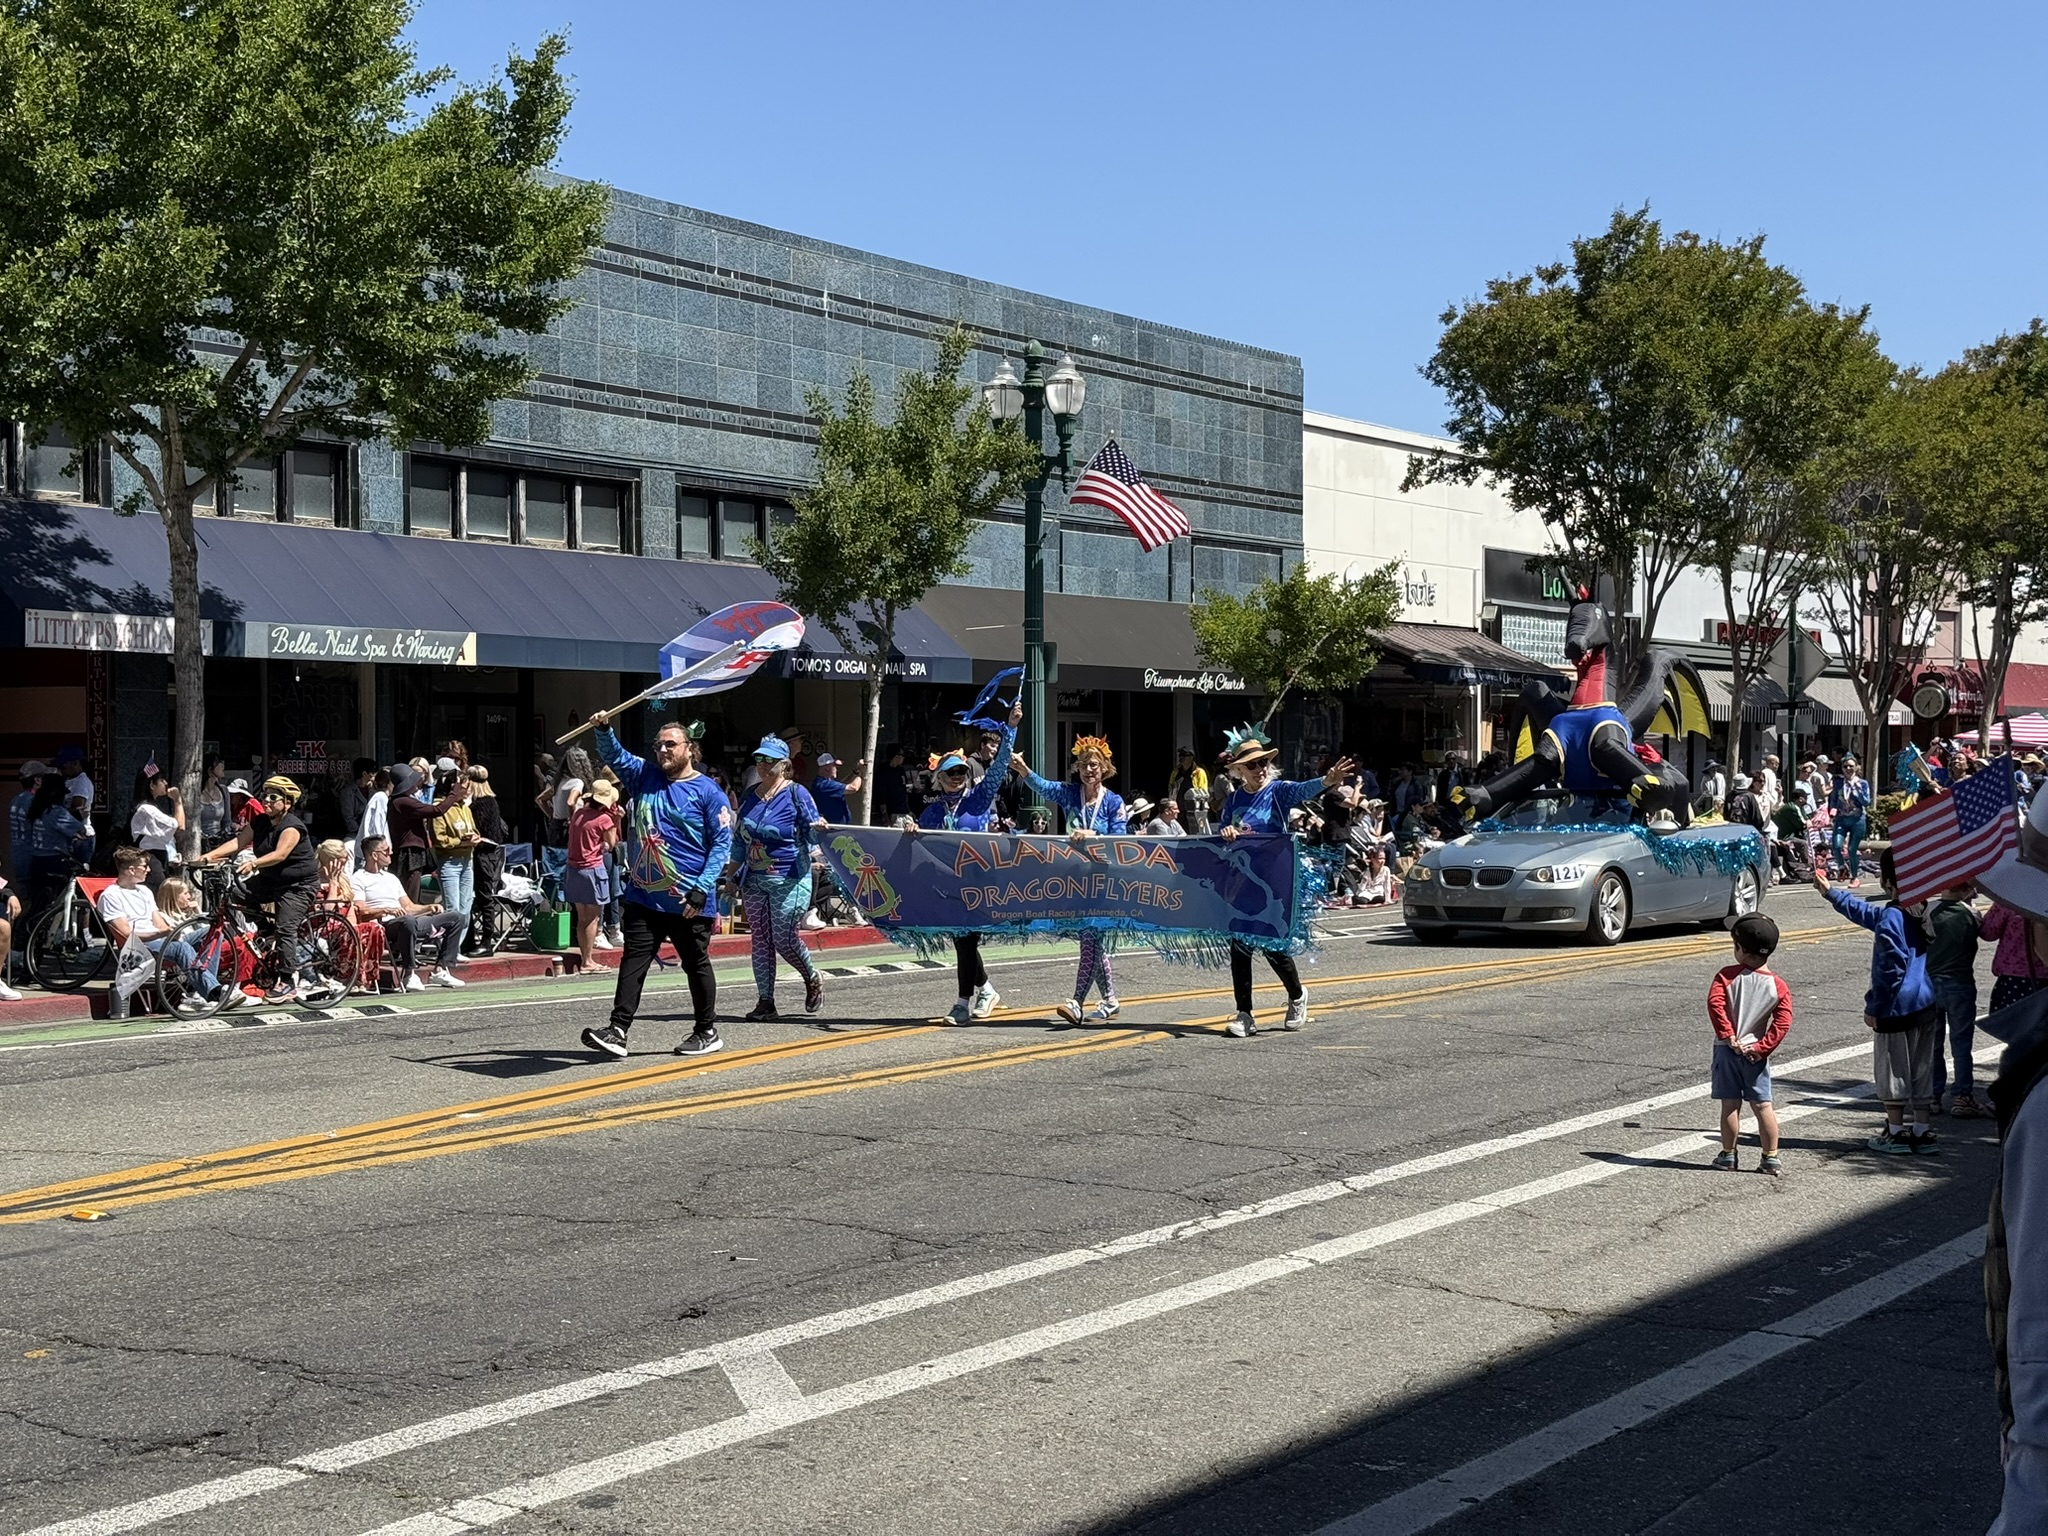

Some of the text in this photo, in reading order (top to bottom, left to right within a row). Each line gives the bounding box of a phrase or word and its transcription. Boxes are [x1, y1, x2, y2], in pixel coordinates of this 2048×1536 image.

[33, 616, 91, 646] LITTLE
[271, 626, 456, 664] Bella Nail Spa & Waxing
[791, 657, 832, 673] TOMO'S
[885, 663, 906, 676] NAIL
[909, 662, 927, 676] SPA
[1144, 667, 1246, 693] Triumphant Life Church
[296, 740, 327, 758] TK
[94, 737, 103, 802] TELLER
[277, 759, 352, 774] BARBER SHOP & SPA
[954, 838, 1179, 877] ALAMEDA
[960, 873, 1184, 911] DRAGONFLYERS
[991, 910, 1024, 919] Dragon
[1026, 909, 1048, 918] Boat
[1048, 908, 1076, 918] Racing
[1078, 908, 1086, 917] in
[1130, 909, 1144, 918] CA
